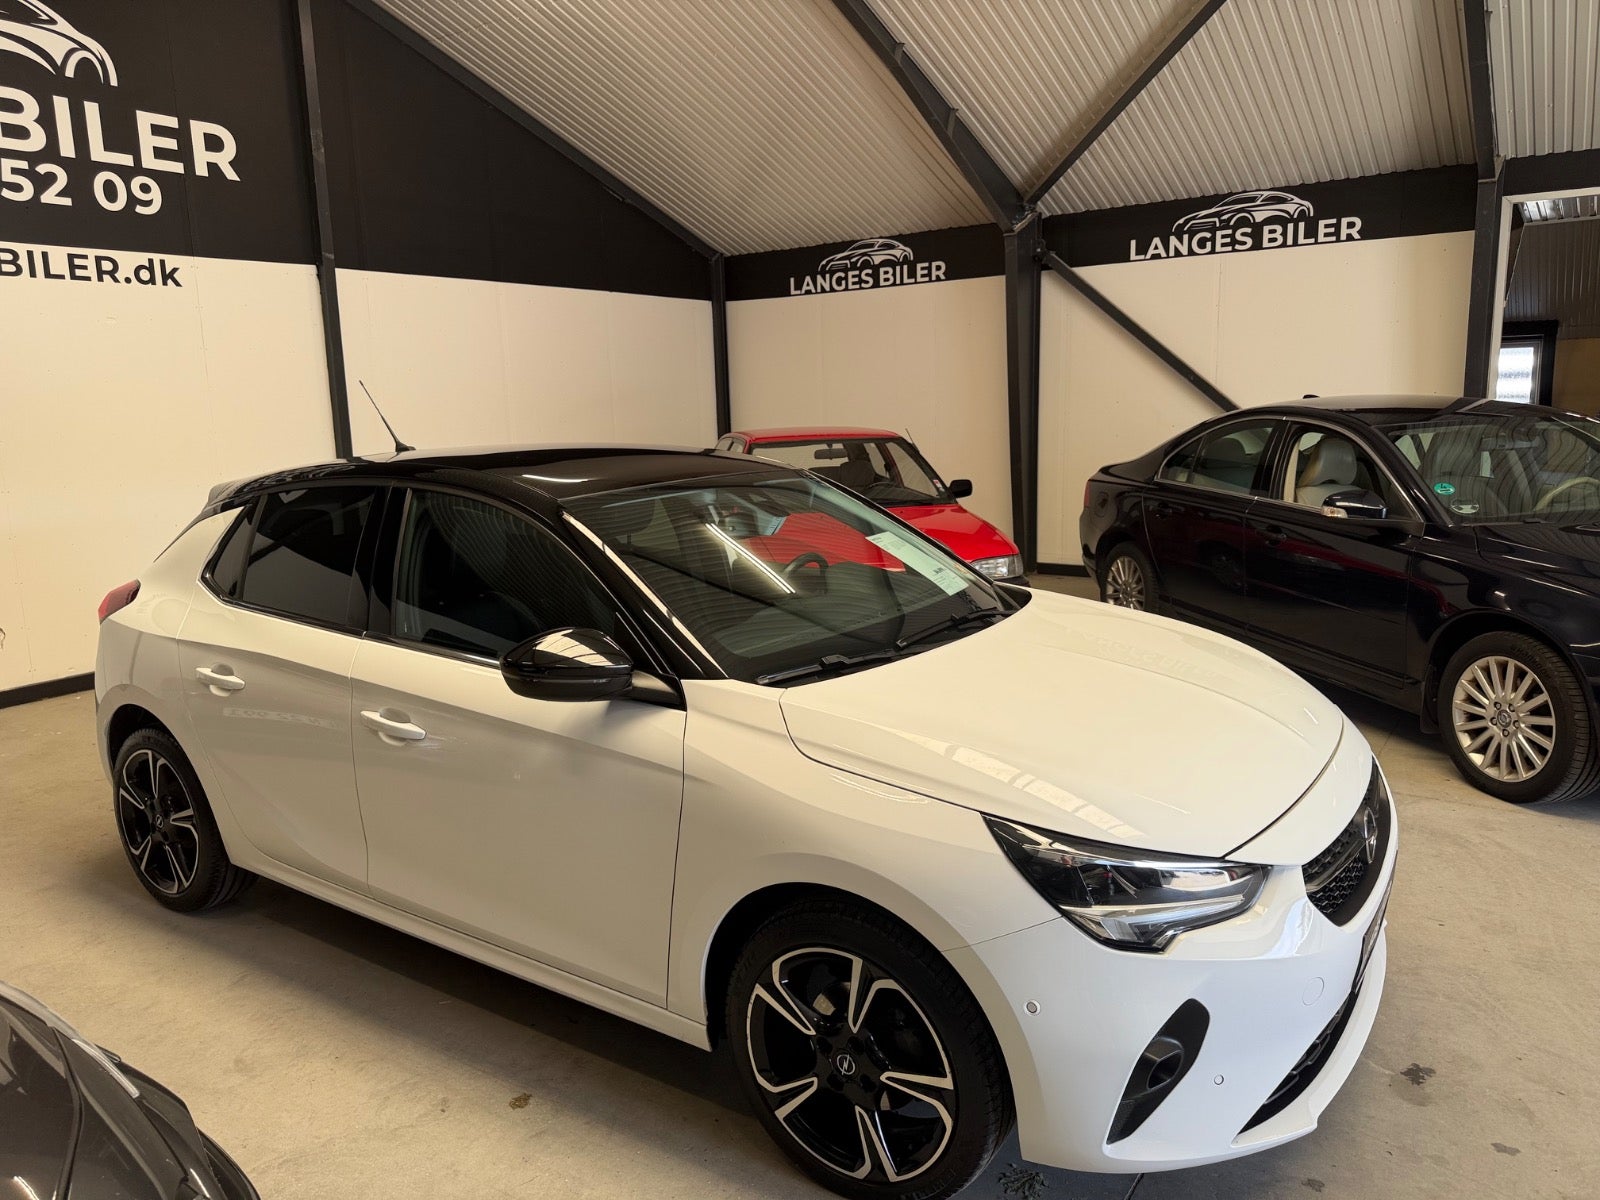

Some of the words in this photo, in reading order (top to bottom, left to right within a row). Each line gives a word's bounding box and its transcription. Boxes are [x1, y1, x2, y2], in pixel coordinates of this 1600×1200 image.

[0, 86, 241, 181] BILER
[0, 157, 73, 206] 52
[93, 171, 162, 215] 09
[1129, 227, 1253, 261] LANGES
[1262, 216, 1362, 248] BILER
[789, 268, 874, 295] LANGES
[879, 260, 947, 286] BILER
